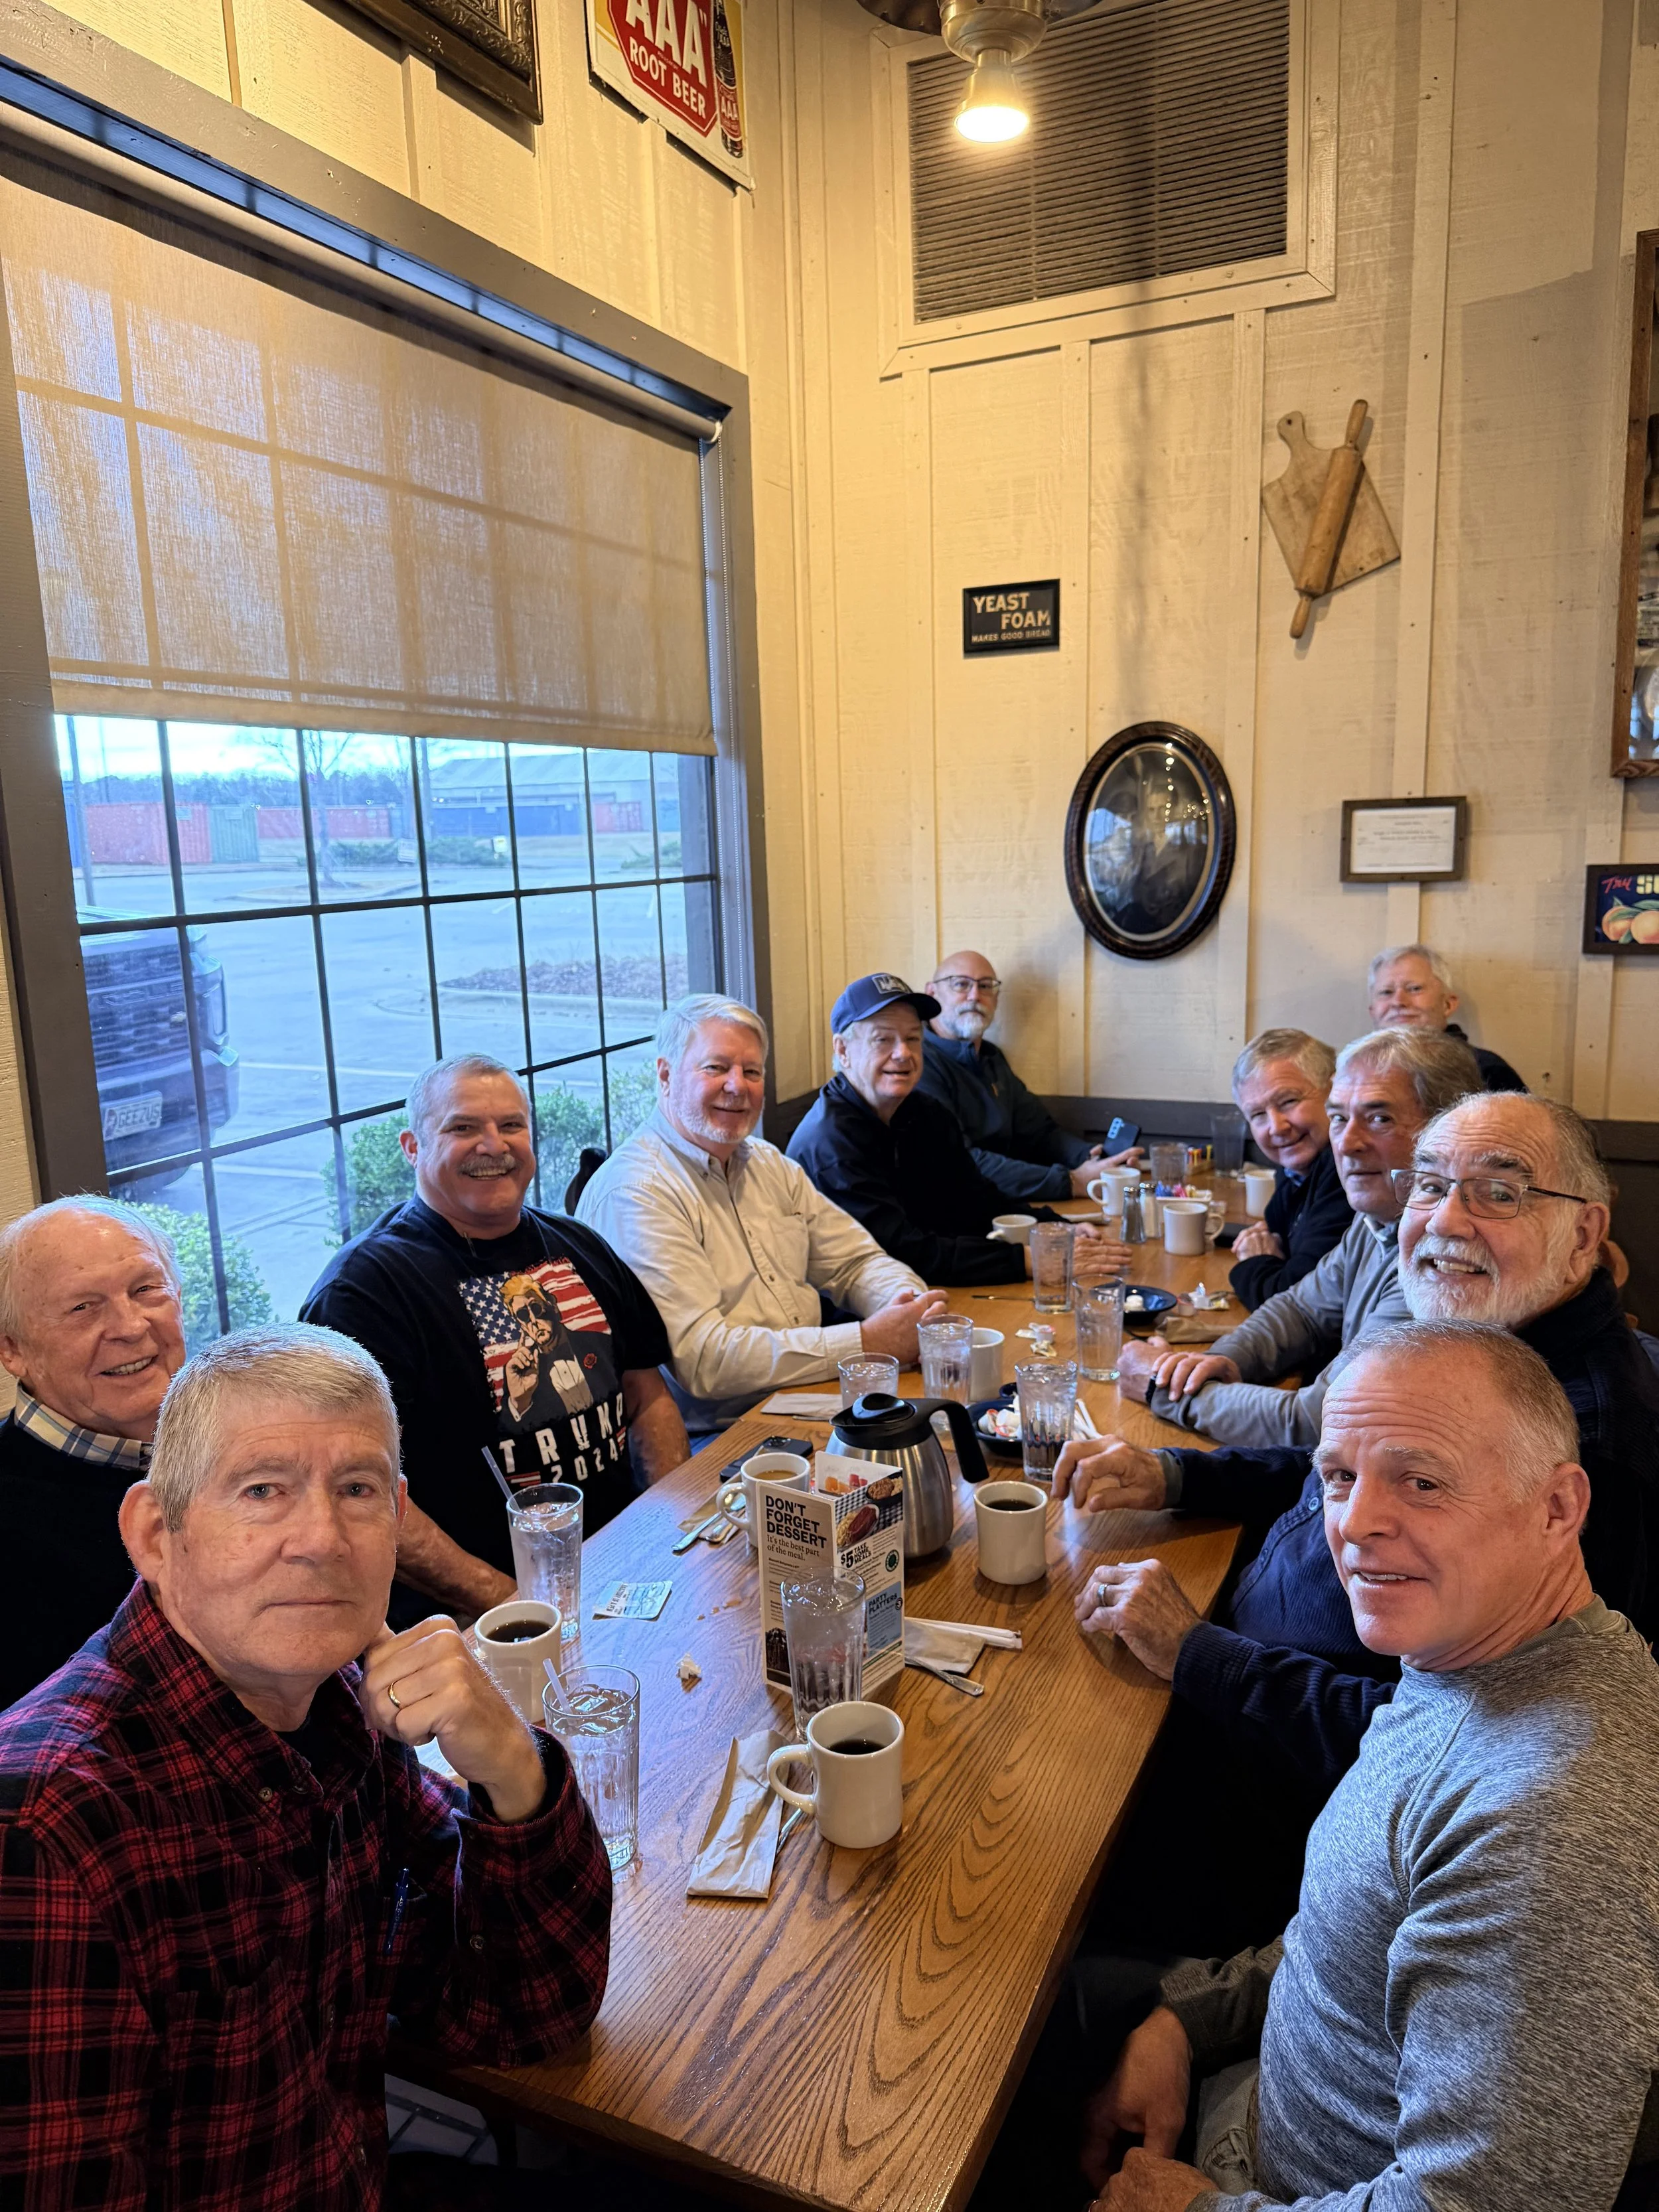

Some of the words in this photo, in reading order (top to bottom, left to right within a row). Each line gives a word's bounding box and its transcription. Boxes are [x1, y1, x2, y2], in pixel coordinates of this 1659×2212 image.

[629, 36, 667, 87] ROOT
[672, 71, 706, 119] BEER
[972, 591, 1030, 614] YEAST
[1001, 609, 1052, 630] FOAM
[972, 633, 999, 643] MAKES
[1001, 631, 1024, 640] GOOD
[766, 1495, 806, 1516] DON'T
[766, 1508, 820, 1534] FORGET
[767, 1520, 828, 1549] DESSERT
[766, 1534, 777, 1544] It's
[778, 1538, 790, 1548] the
[790, 1540, 805, 1552] best
[806, 1547, 820, 1557] part
[776, 1546, 786, 1555] the
[787, 1550, 806, 1562] meal.
[854, 1542, 867, 1554] TAKE
[841, 1550, 854, 1568] $5
[869, 1592, 887, 1606] PARTY
[869, 1593, 897, 1614] PLATTERS
